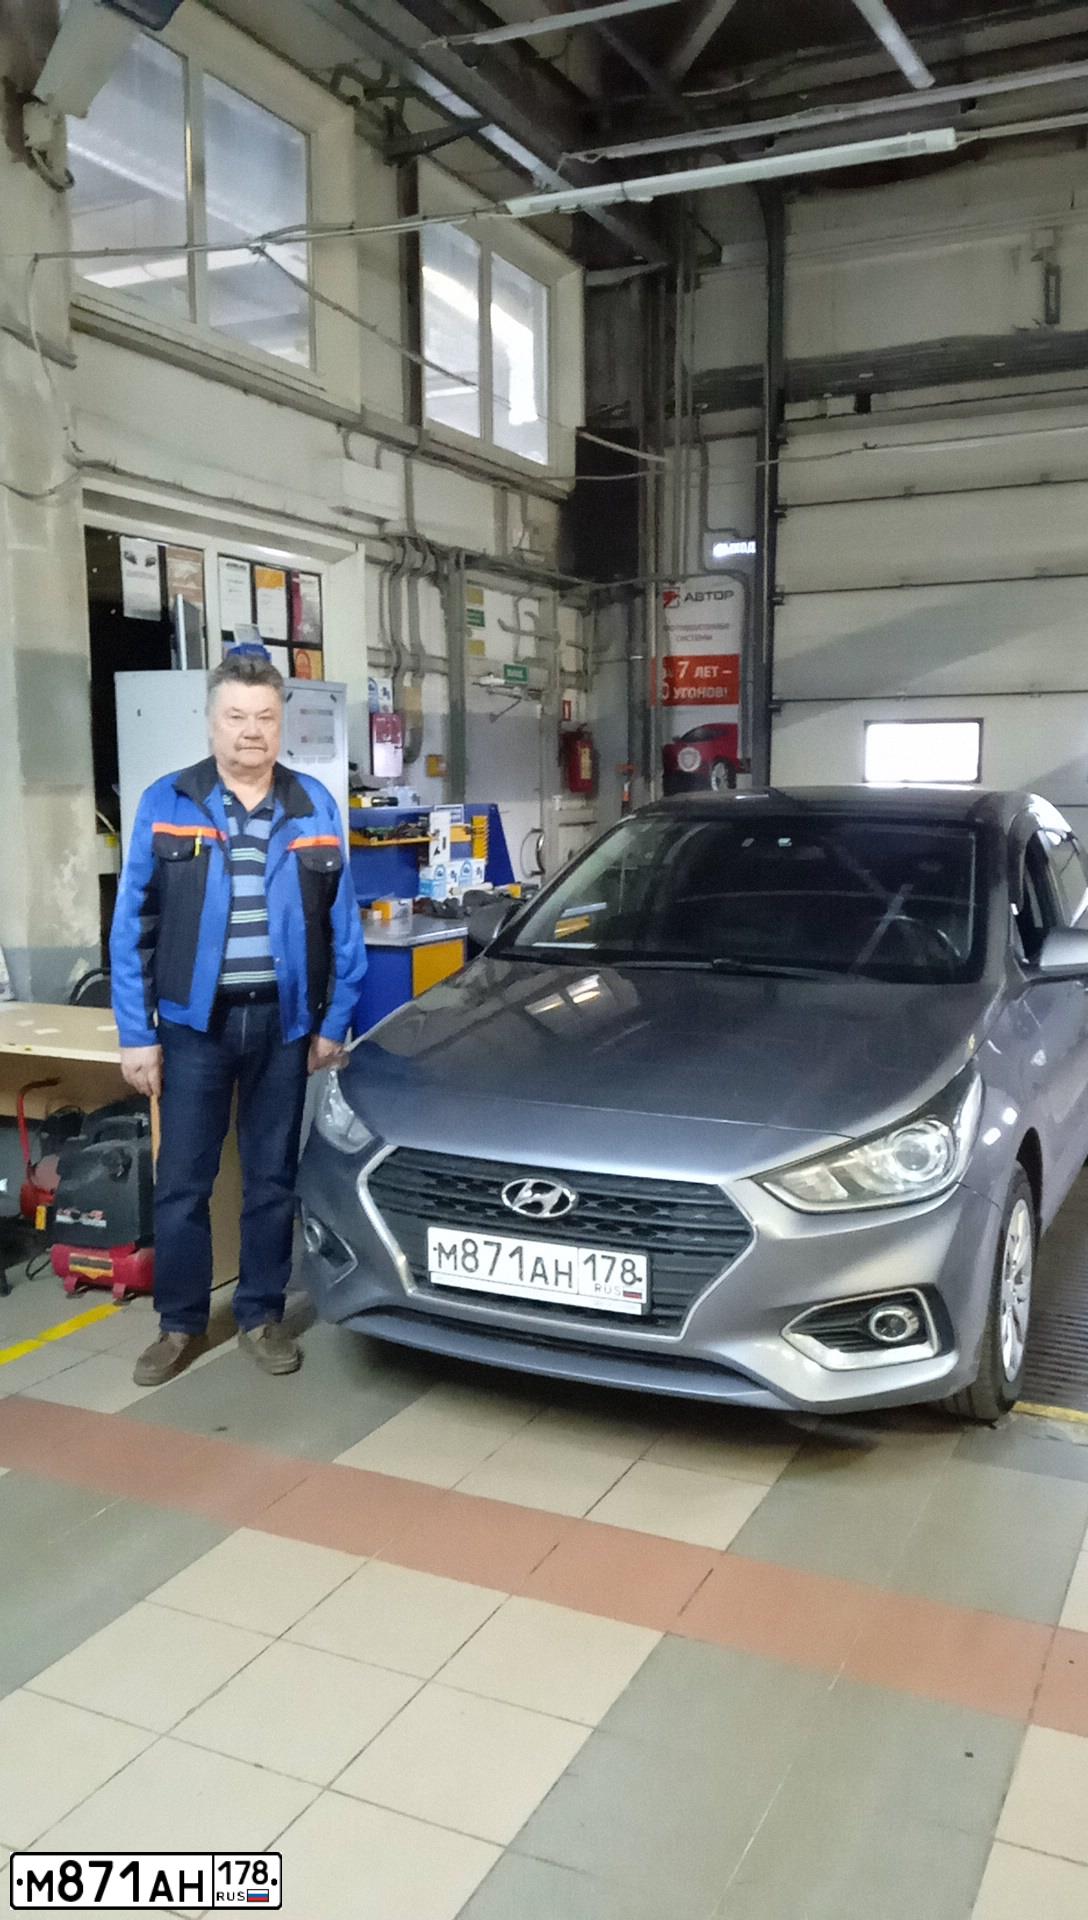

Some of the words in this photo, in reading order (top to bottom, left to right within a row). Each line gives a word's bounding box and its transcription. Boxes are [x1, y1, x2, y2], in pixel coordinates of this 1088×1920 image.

[684, 590, 735, 602] АВТОР
[678, 661, 690, 679] 7
[693, 666, 719, 678] ЛЕТ
[673, 686, 728, 700] УГОНОВ!
[437, 1238, 573, 1288] М871АН
[583, 1253, 637, 1286] 178
[594, 1283, 622, 1297] RUS
